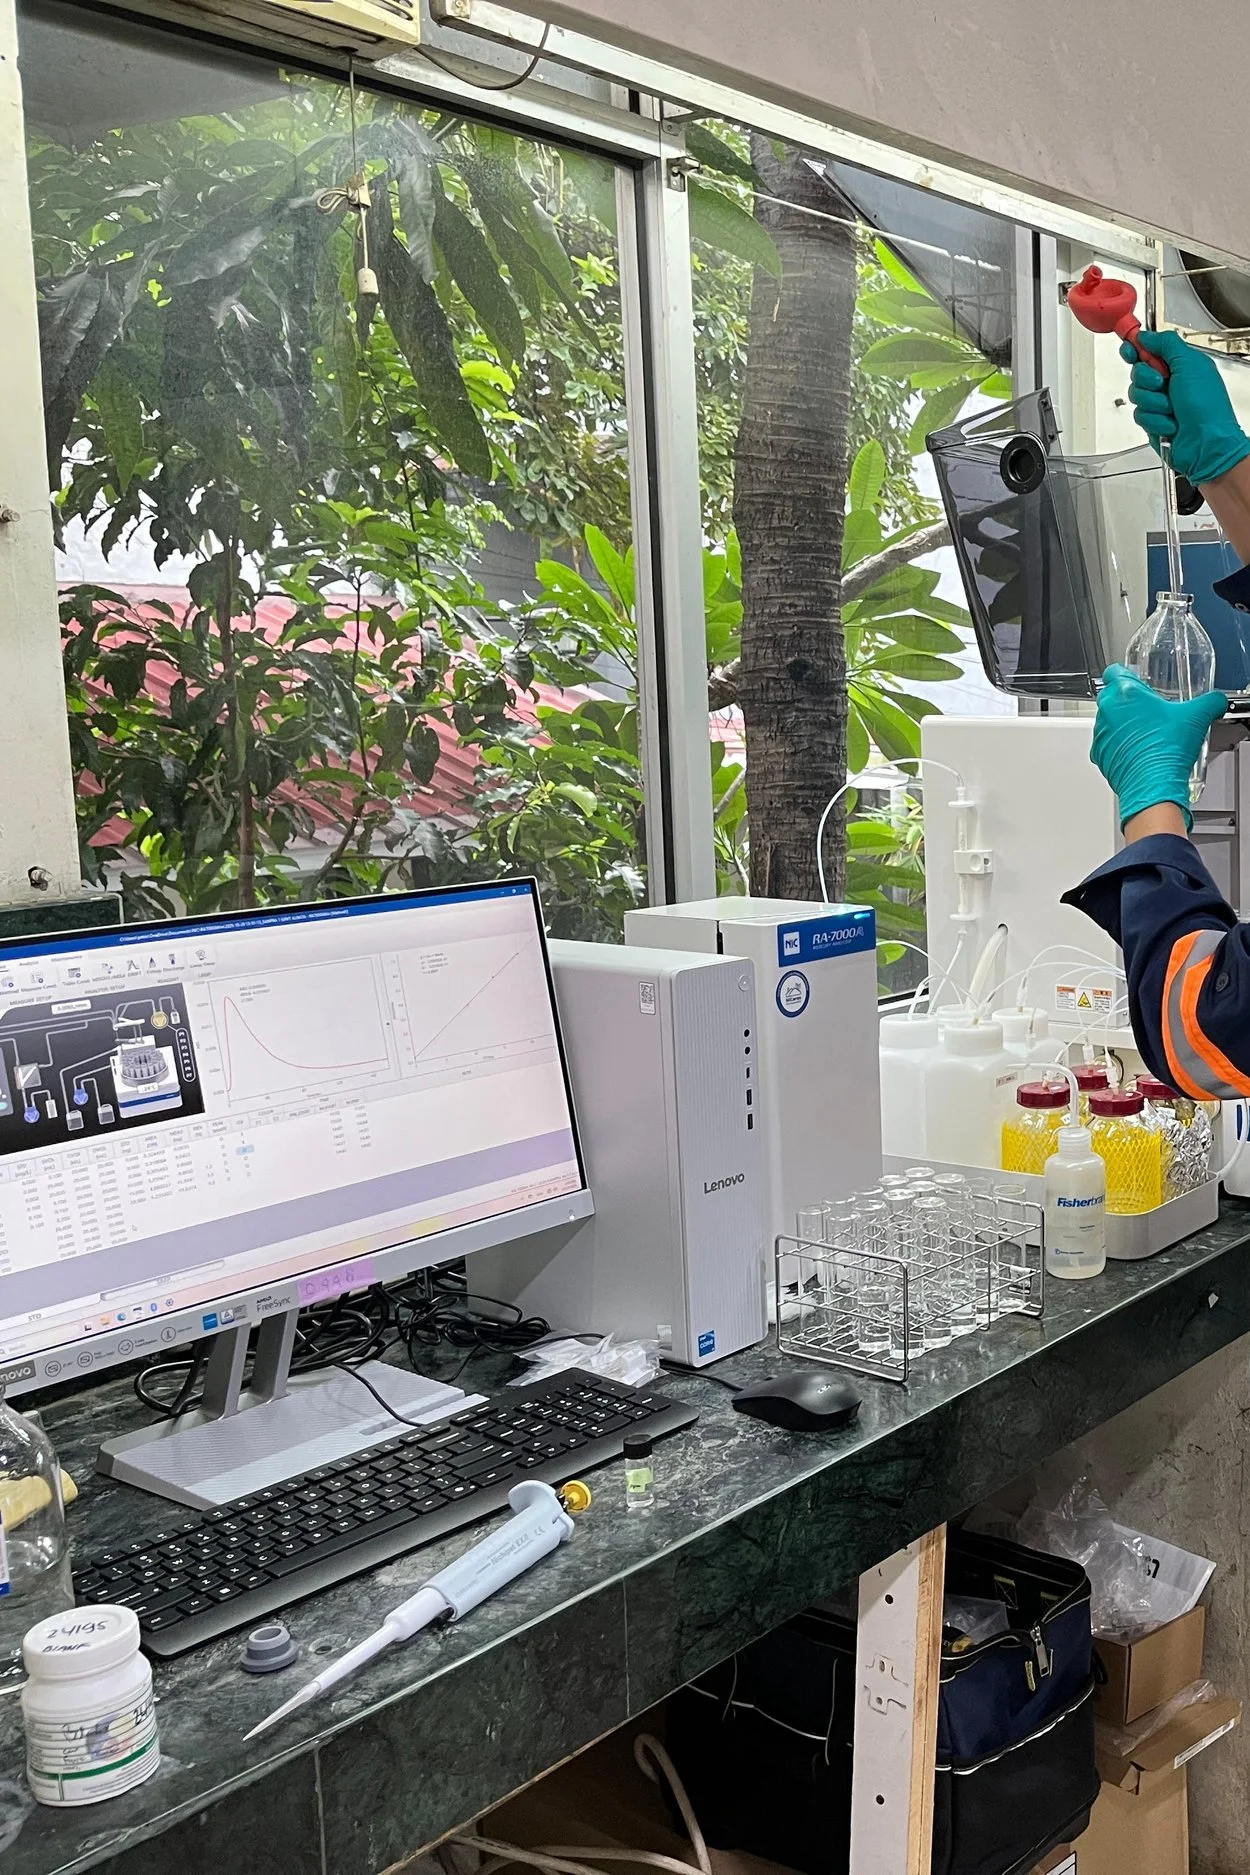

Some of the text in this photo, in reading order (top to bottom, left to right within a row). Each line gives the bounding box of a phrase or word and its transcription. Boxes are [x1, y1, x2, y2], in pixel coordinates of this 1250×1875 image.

[812, 926, 865, 945] RA-7000A
[704, 1173, 745, 1194] Lenovo
[1057, 1194, 1105, 1208] Fisherbra
[256, 1297, 292, 1312] FreeSync
[0, 1367, 31, 1382] novo
